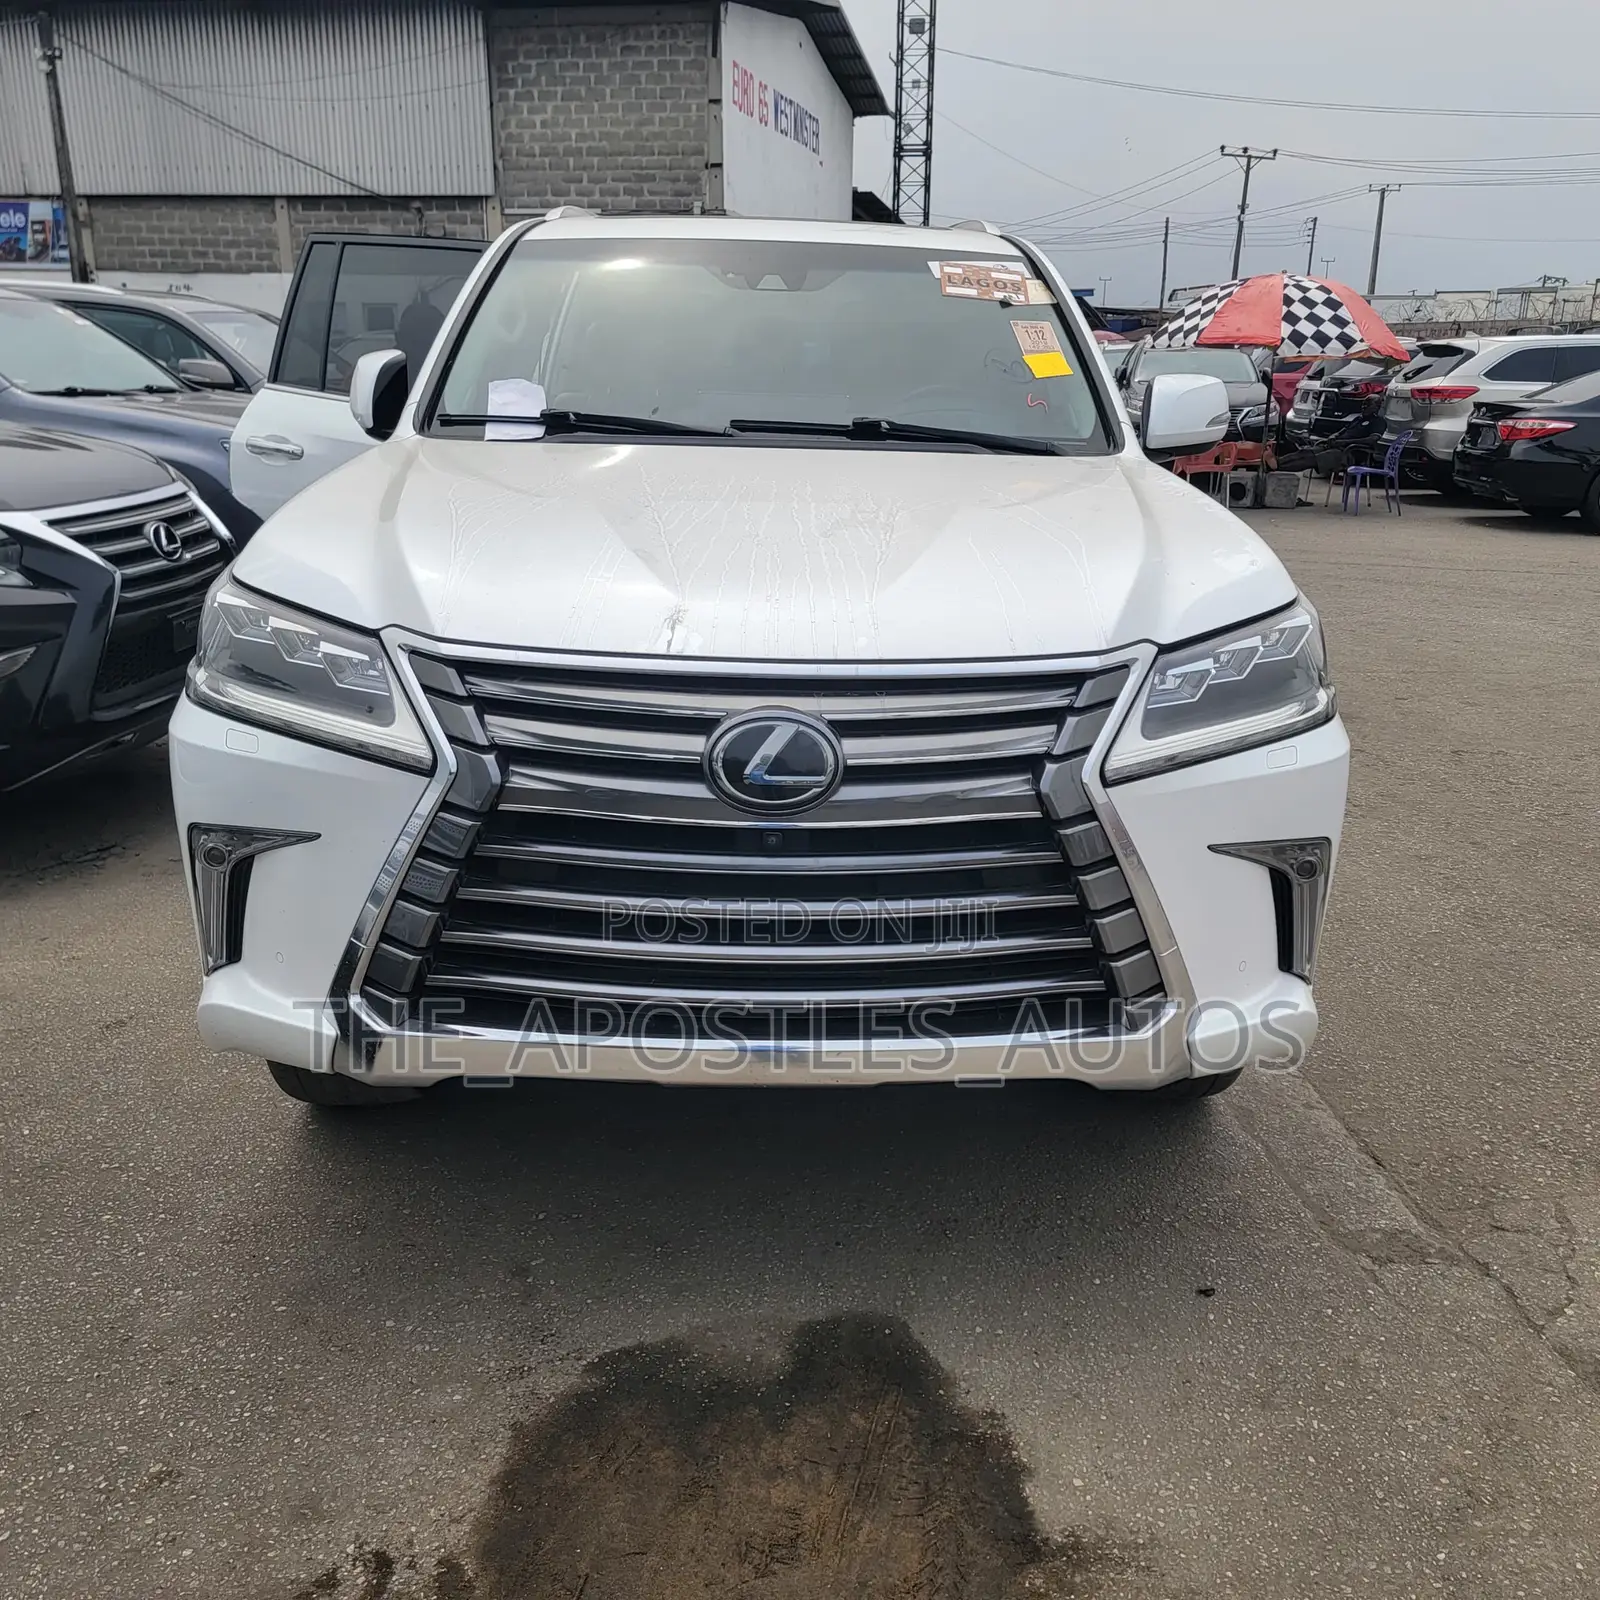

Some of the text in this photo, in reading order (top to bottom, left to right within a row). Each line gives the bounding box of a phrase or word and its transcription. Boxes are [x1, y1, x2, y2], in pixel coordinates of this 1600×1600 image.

[732, 60, 755, 119] EURO
[758, 80, 769, 127] 65
[947, 275, 1022, 291] LAGOS
[1024, 329, 1048, 341] 1:12
